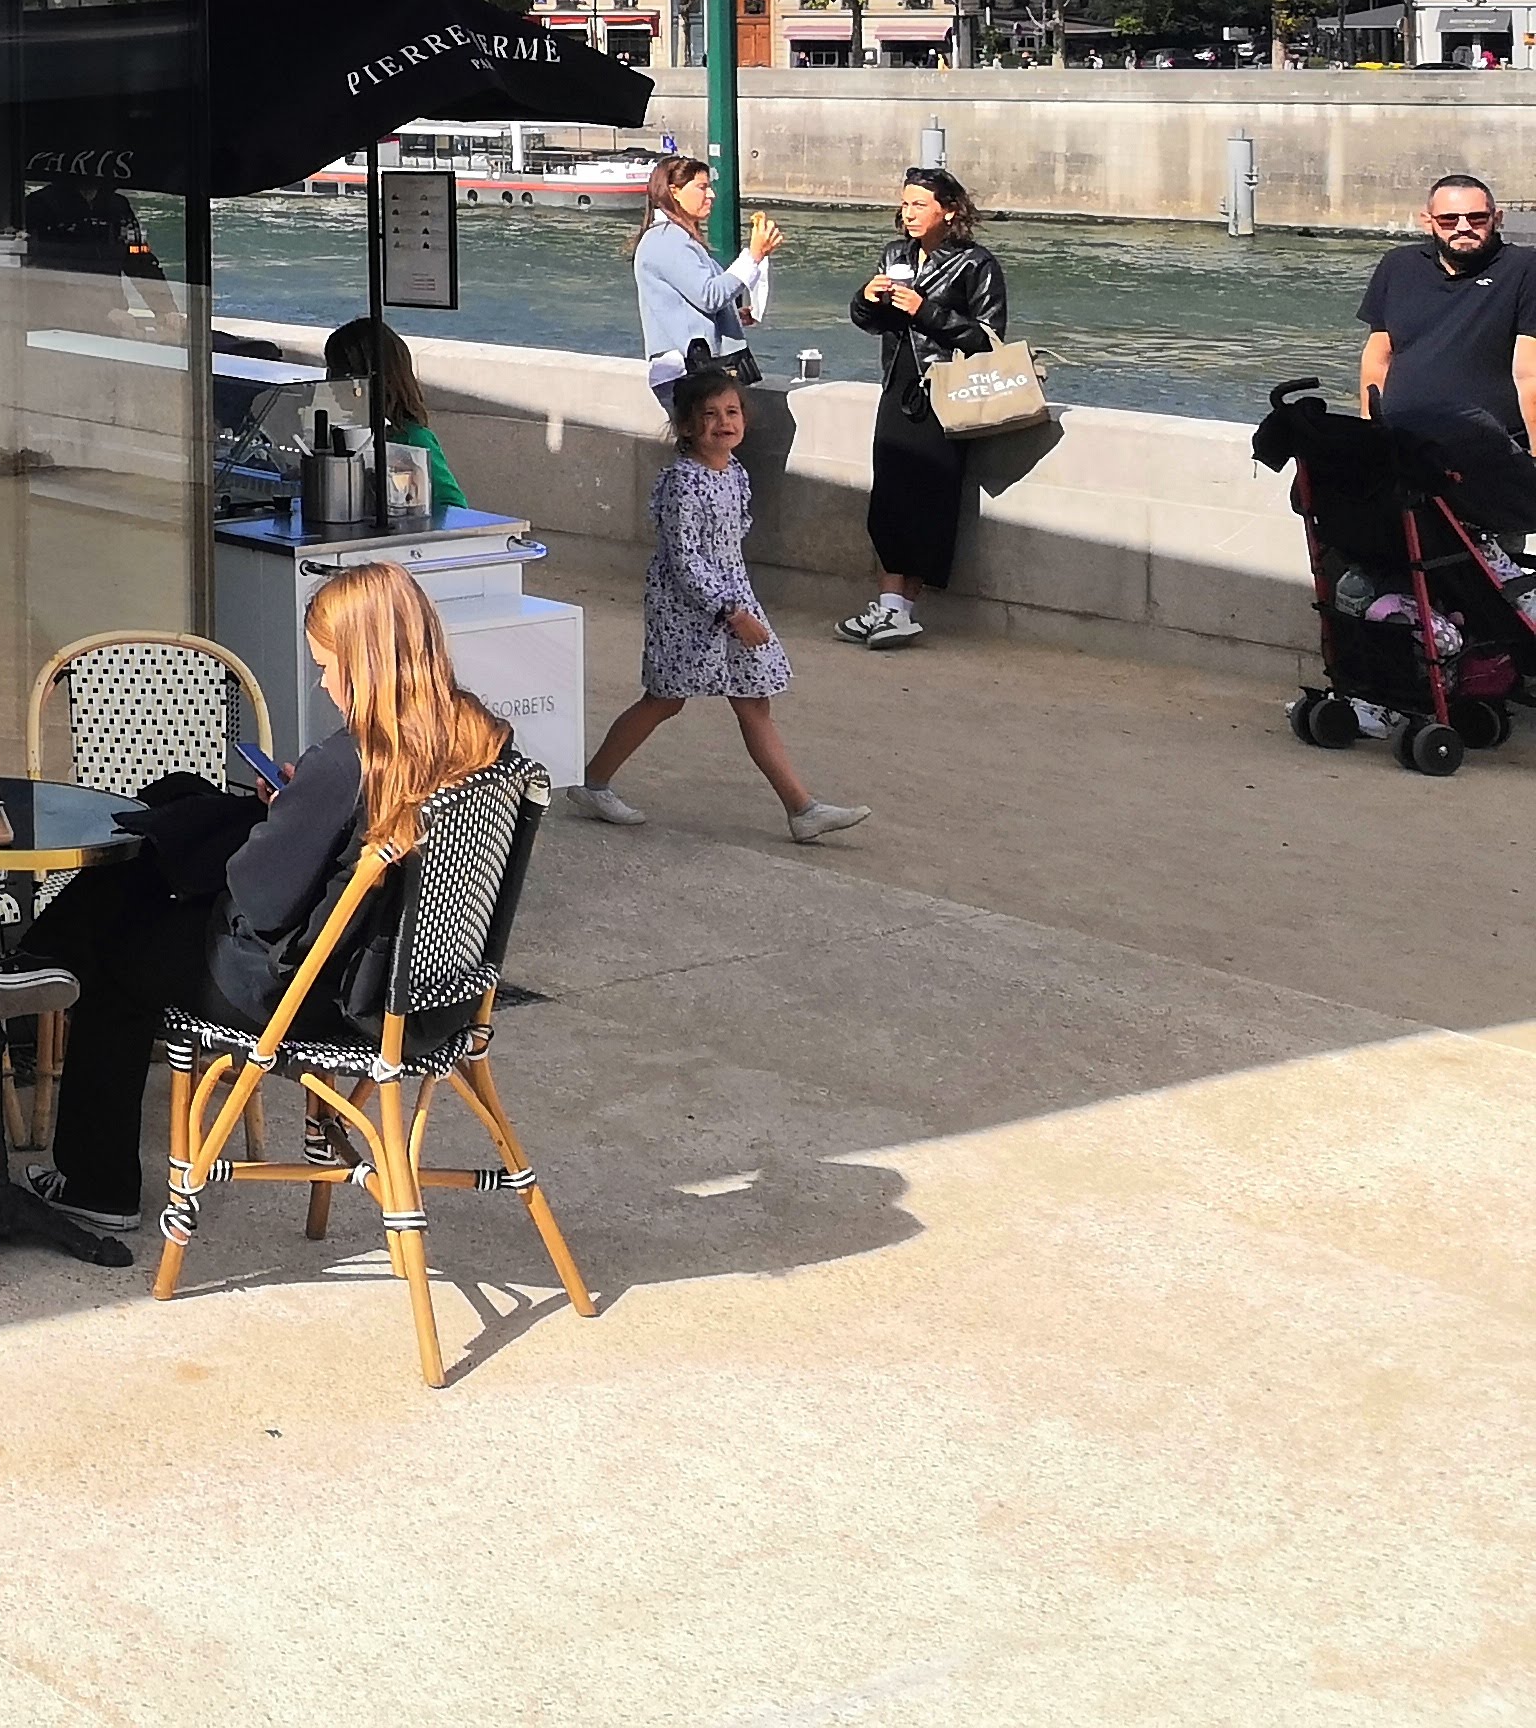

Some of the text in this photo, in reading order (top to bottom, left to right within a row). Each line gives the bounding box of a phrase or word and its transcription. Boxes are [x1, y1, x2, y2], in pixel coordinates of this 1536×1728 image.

[346, 24, 471, 96] PIERRE
[948, 385, 990, 401] TOTE
[993, 374, 1028, 392] BAG
[968, 370, 1001, 385] THE
[492, 695, 555, 718] SORBETS
